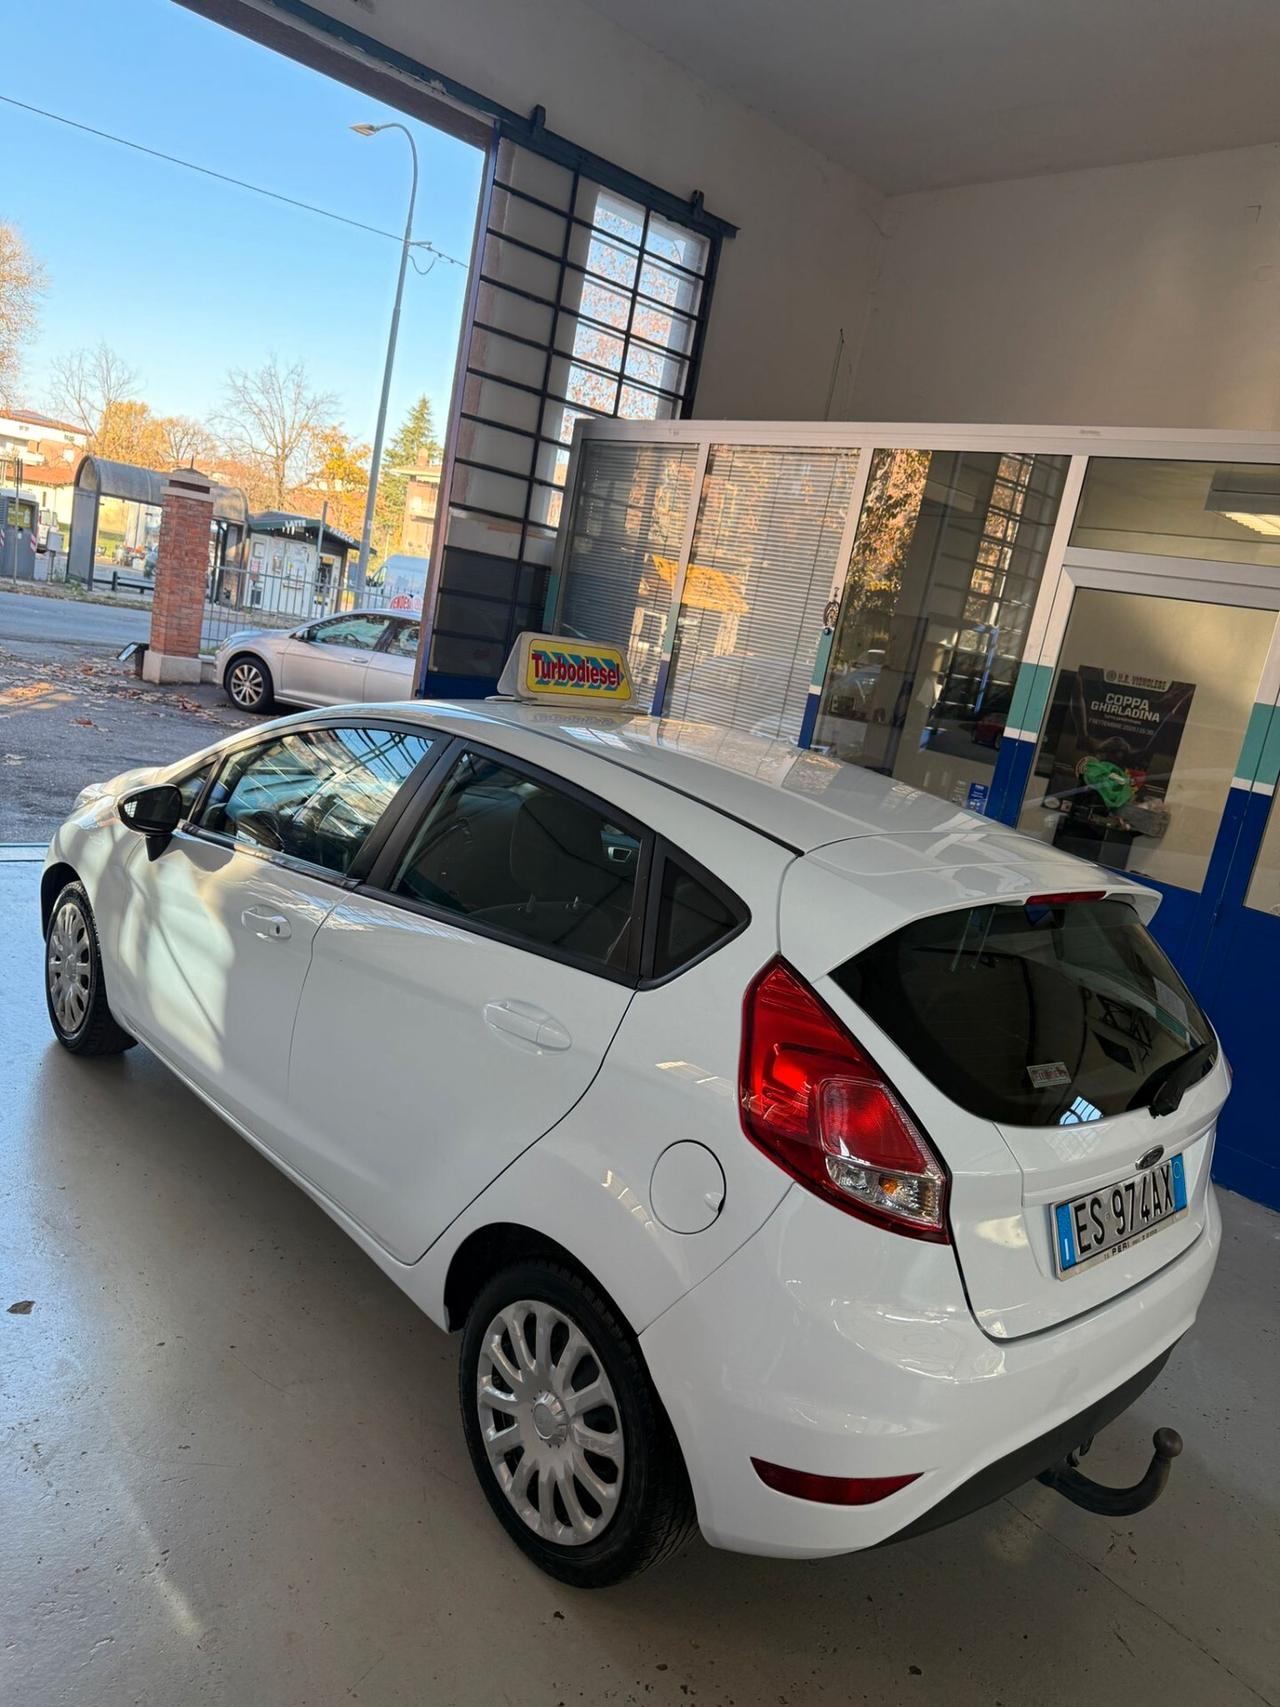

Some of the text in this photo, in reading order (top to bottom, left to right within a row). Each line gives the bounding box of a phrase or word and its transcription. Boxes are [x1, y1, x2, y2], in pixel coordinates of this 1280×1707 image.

[531, 653, 621, 687] Turbodiesel
[1090, 700, 1161, 723] GHIRLADINA
[1105, 692, 1150, 711] COPPA
[1073, 1164, 1173, 1254] ES 974AX
